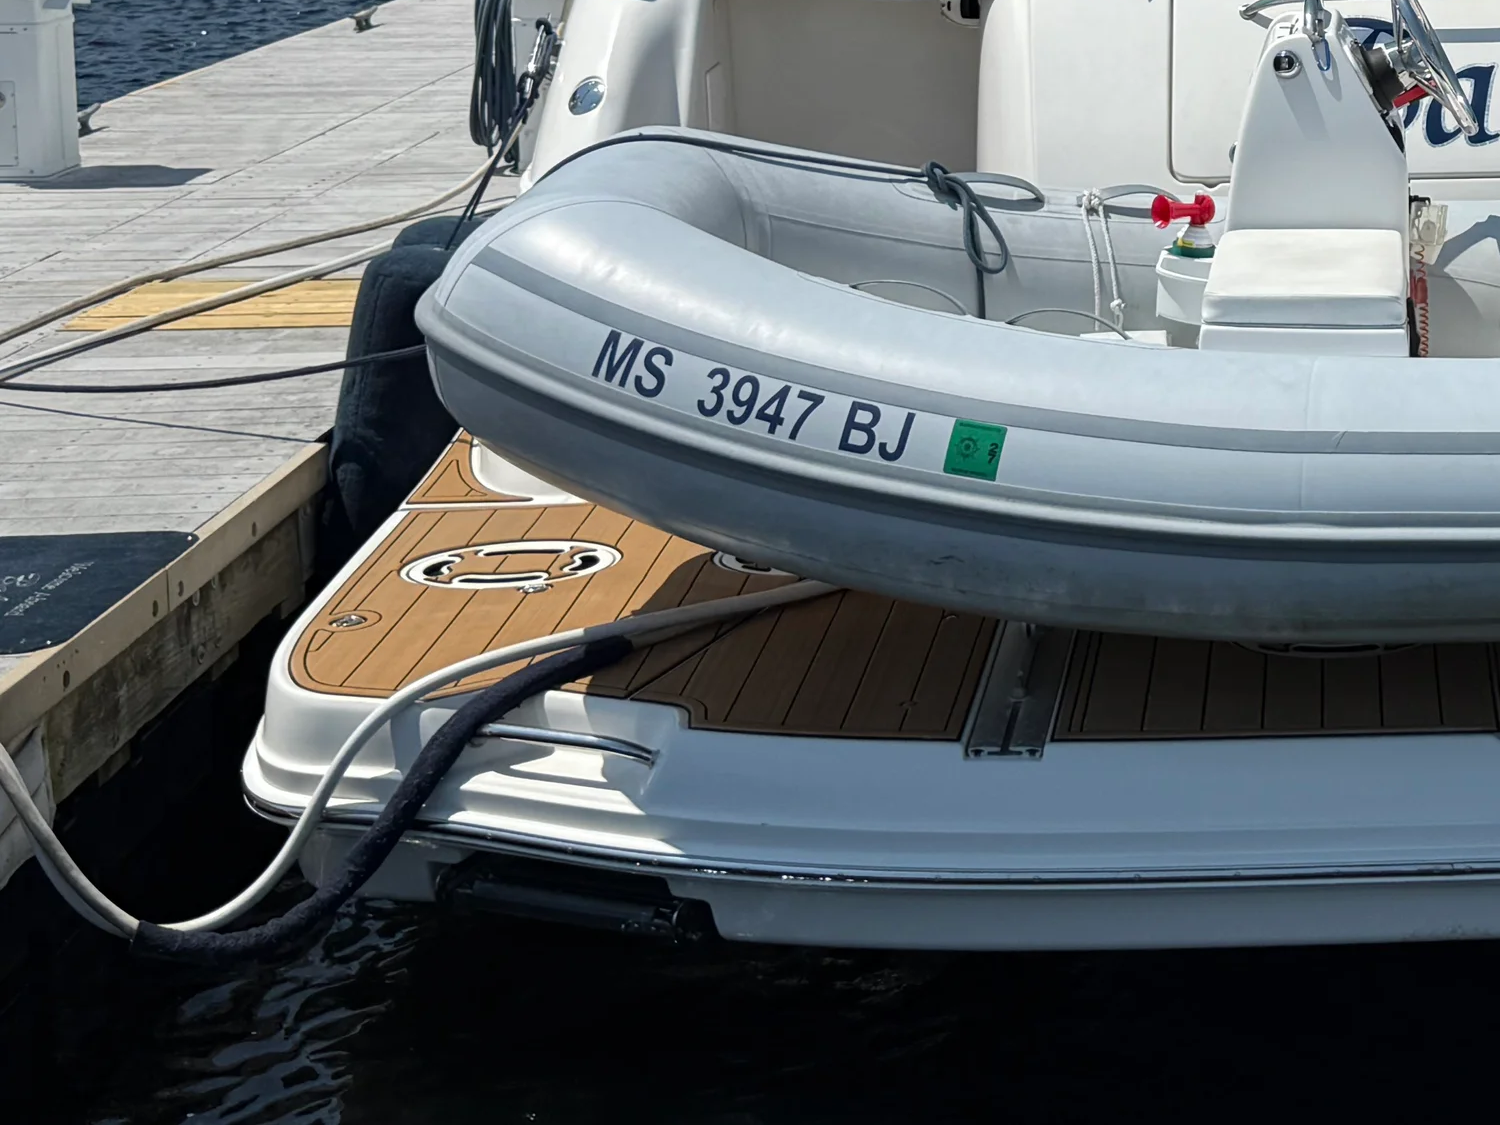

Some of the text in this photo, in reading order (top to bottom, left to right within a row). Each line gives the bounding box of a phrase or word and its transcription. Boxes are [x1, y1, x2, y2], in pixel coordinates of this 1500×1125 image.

[591, 329, 916, 462] MS 3947 BJ
